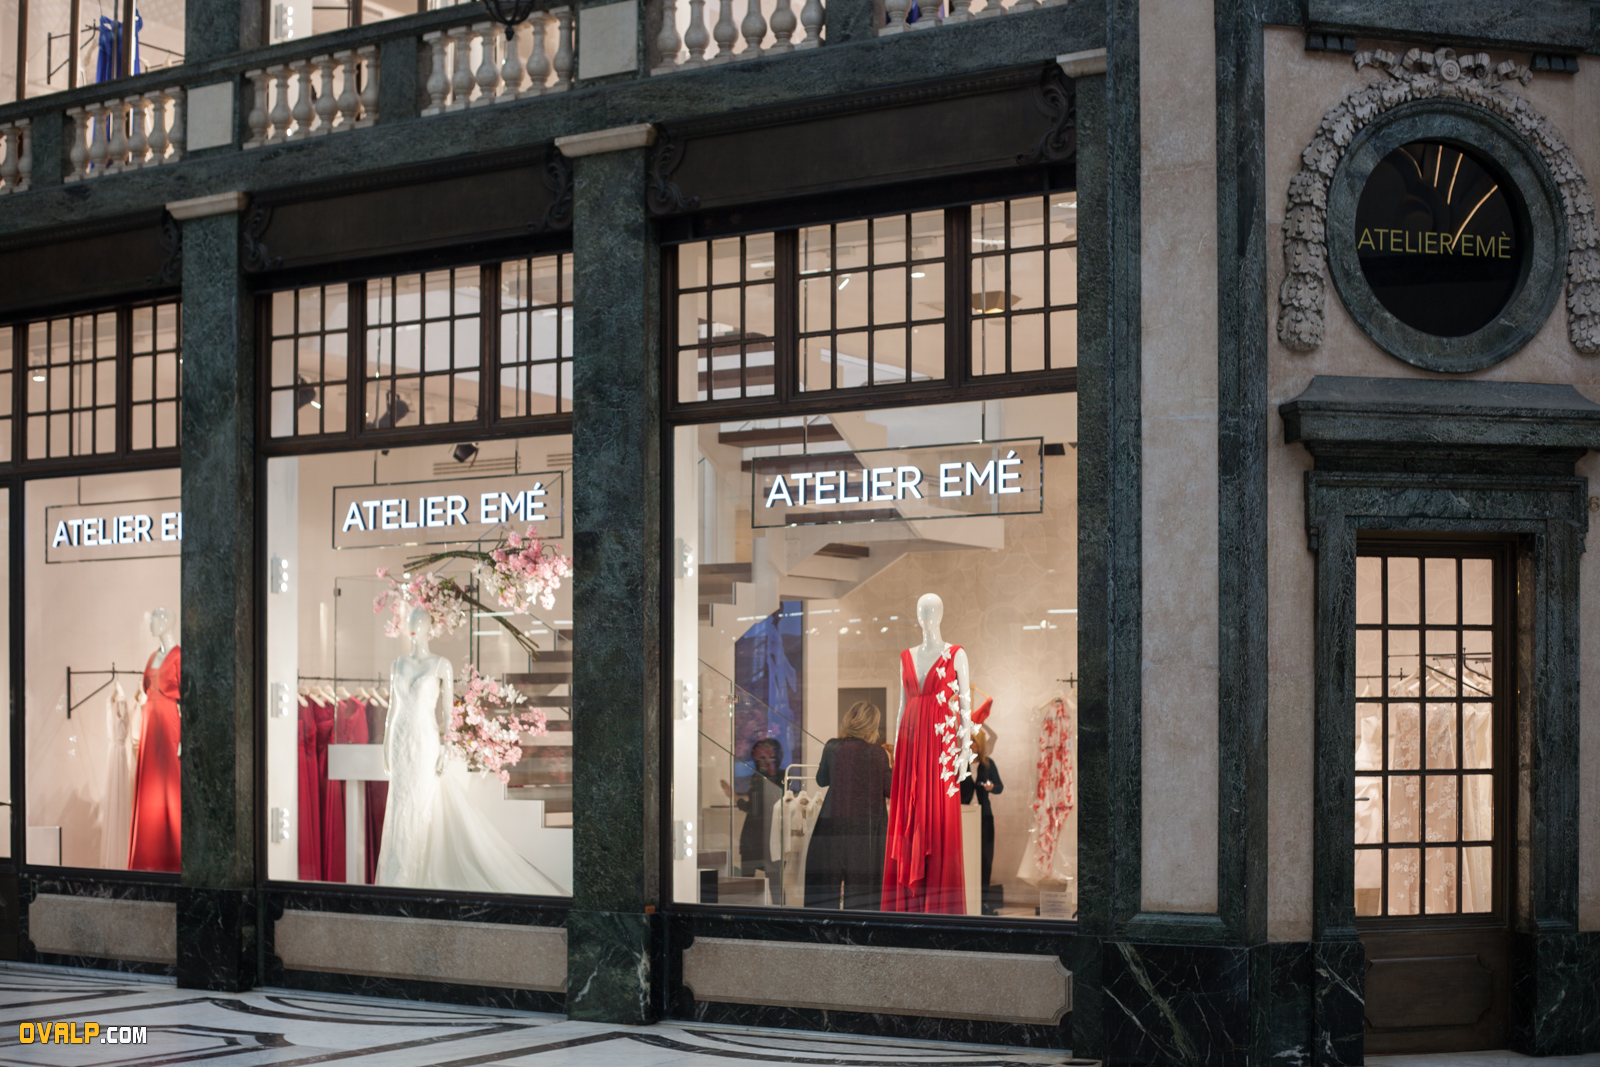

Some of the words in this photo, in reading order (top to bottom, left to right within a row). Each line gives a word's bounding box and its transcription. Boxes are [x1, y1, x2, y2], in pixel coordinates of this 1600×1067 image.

[1357, 228, 1453, 256] ATELIER
[1461, 231, 1511, 259] EMÈ
[765, 465, 923, 508] ATELIER
[939, 450, 1022, 498] EMÉ
[342, 495, 468, 533] ATELIER
[480, 481, 547, 524] EMÉ
[52, 514, 152, 548] ATELIER
